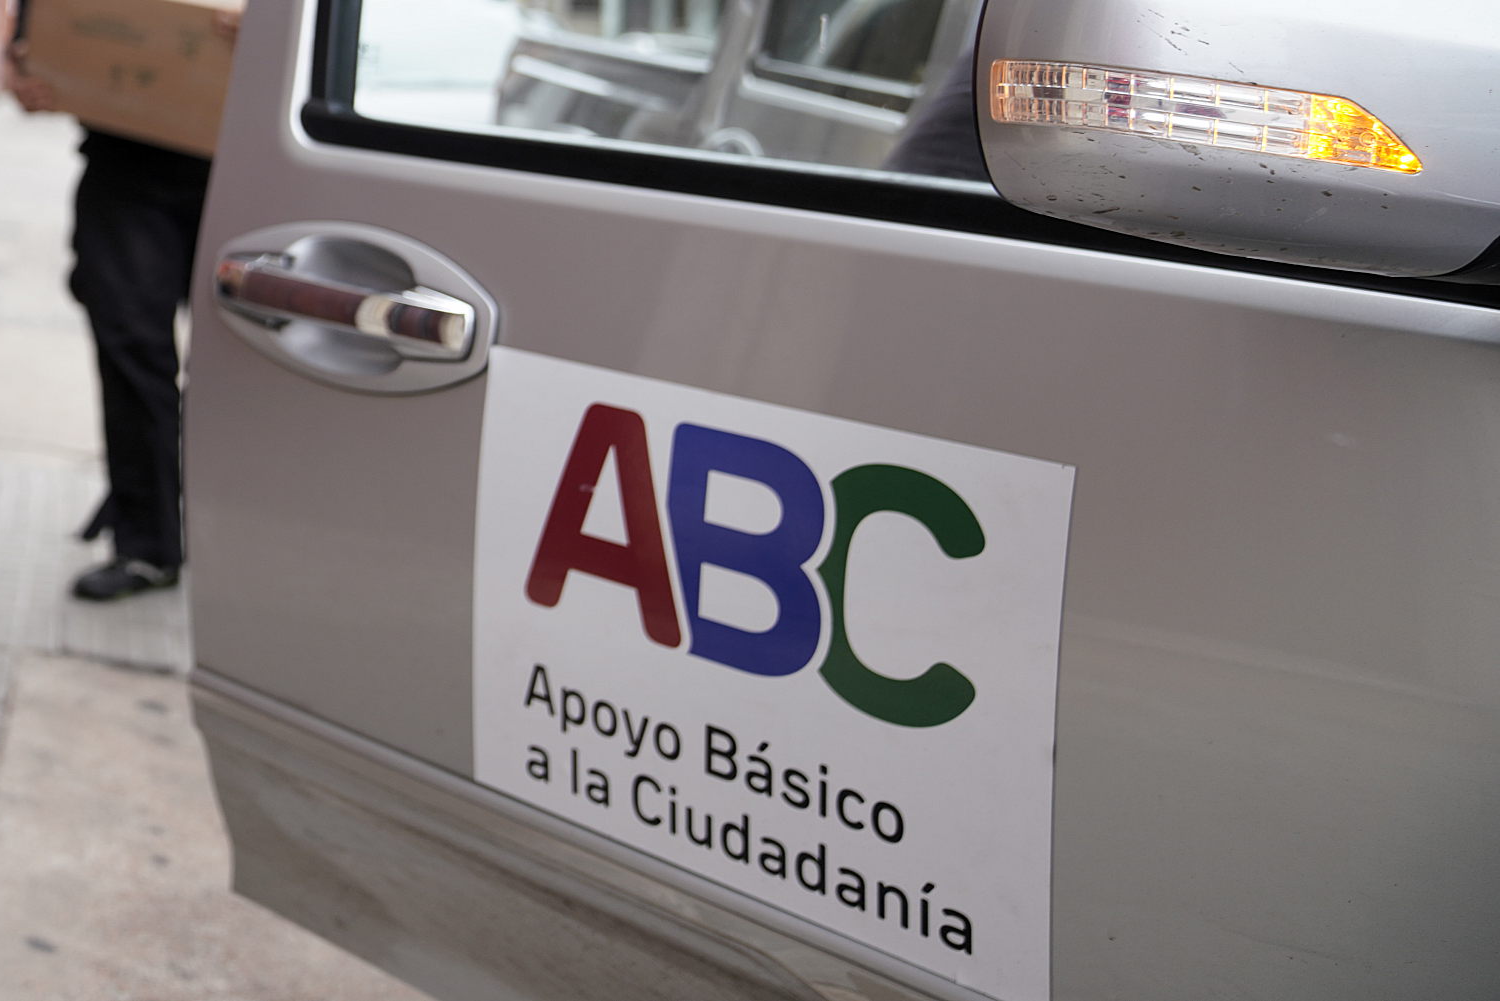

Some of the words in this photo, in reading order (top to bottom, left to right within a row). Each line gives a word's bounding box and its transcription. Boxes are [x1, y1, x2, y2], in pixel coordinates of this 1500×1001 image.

[524, 401, 986, 729] ABC
[523, 663, 682, 762] Apoyo
[703, 723, 906, 845] Básico
[525, 744, 551, 784] a
[570, 747, 611, 809] la
[630, 773, 974, 956] Ciudadanía
